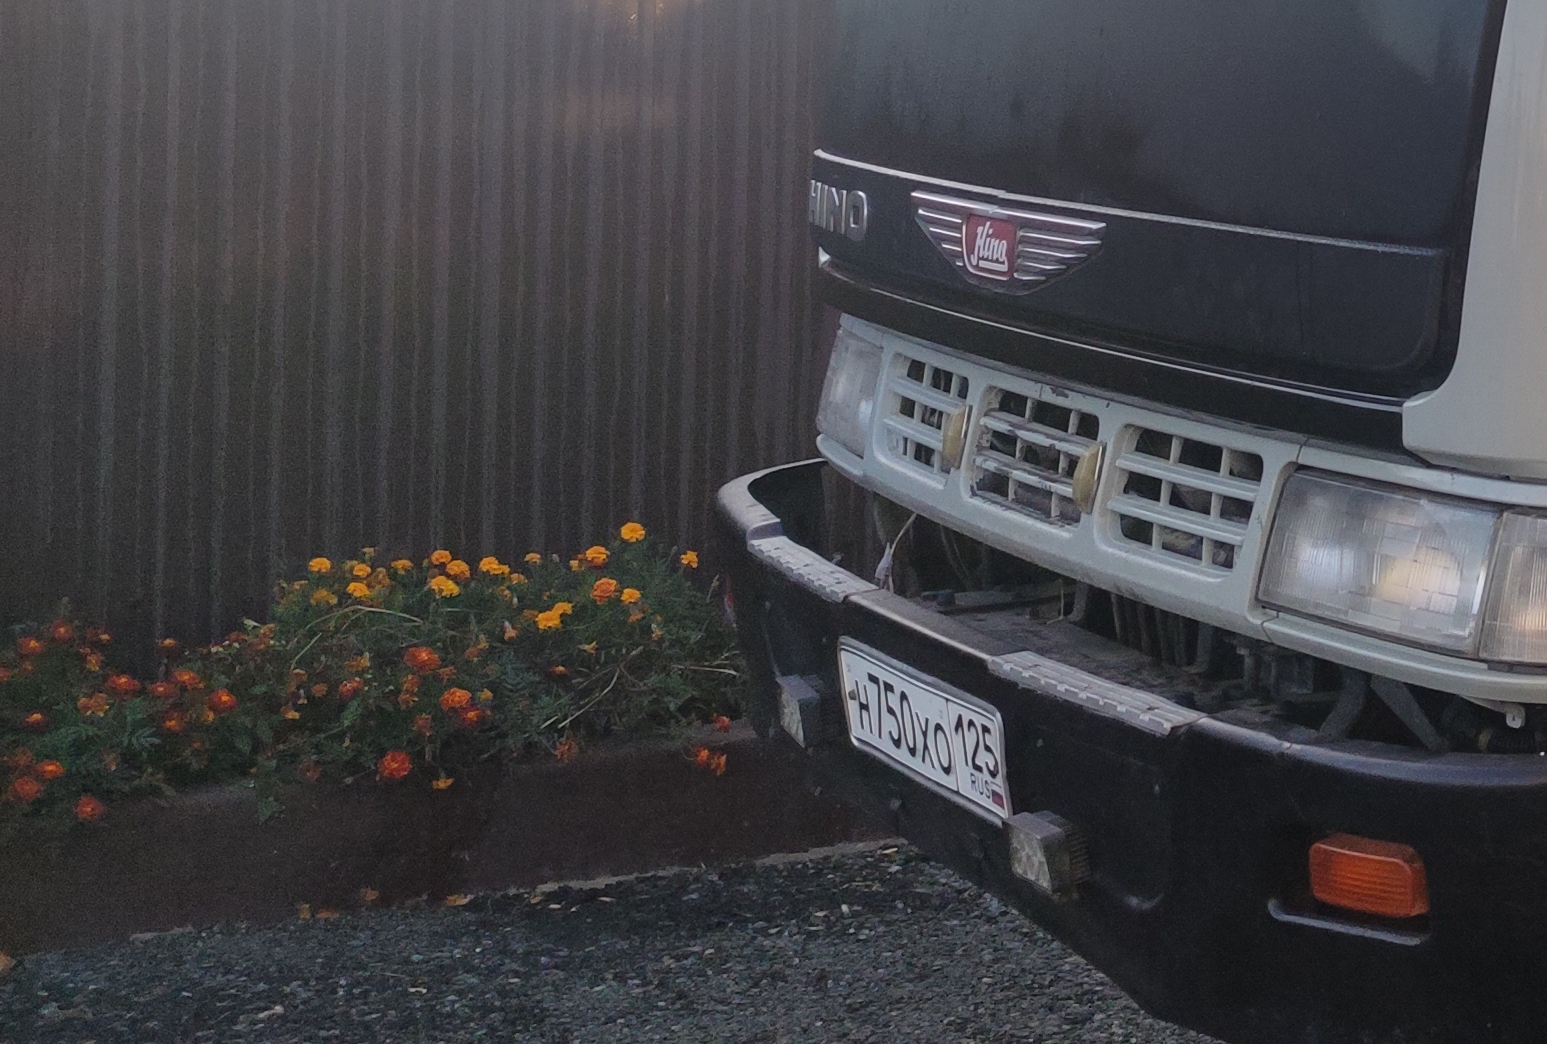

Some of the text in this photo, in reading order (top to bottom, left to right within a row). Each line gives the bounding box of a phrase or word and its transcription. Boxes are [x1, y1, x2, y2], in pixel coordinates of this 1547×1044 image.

[808, 179, 868, 241] HINO
[970, 221, 1008, 271] Hino
[954, 713, 1000, 779] 125
[969, 773, 992, 800] RUS
